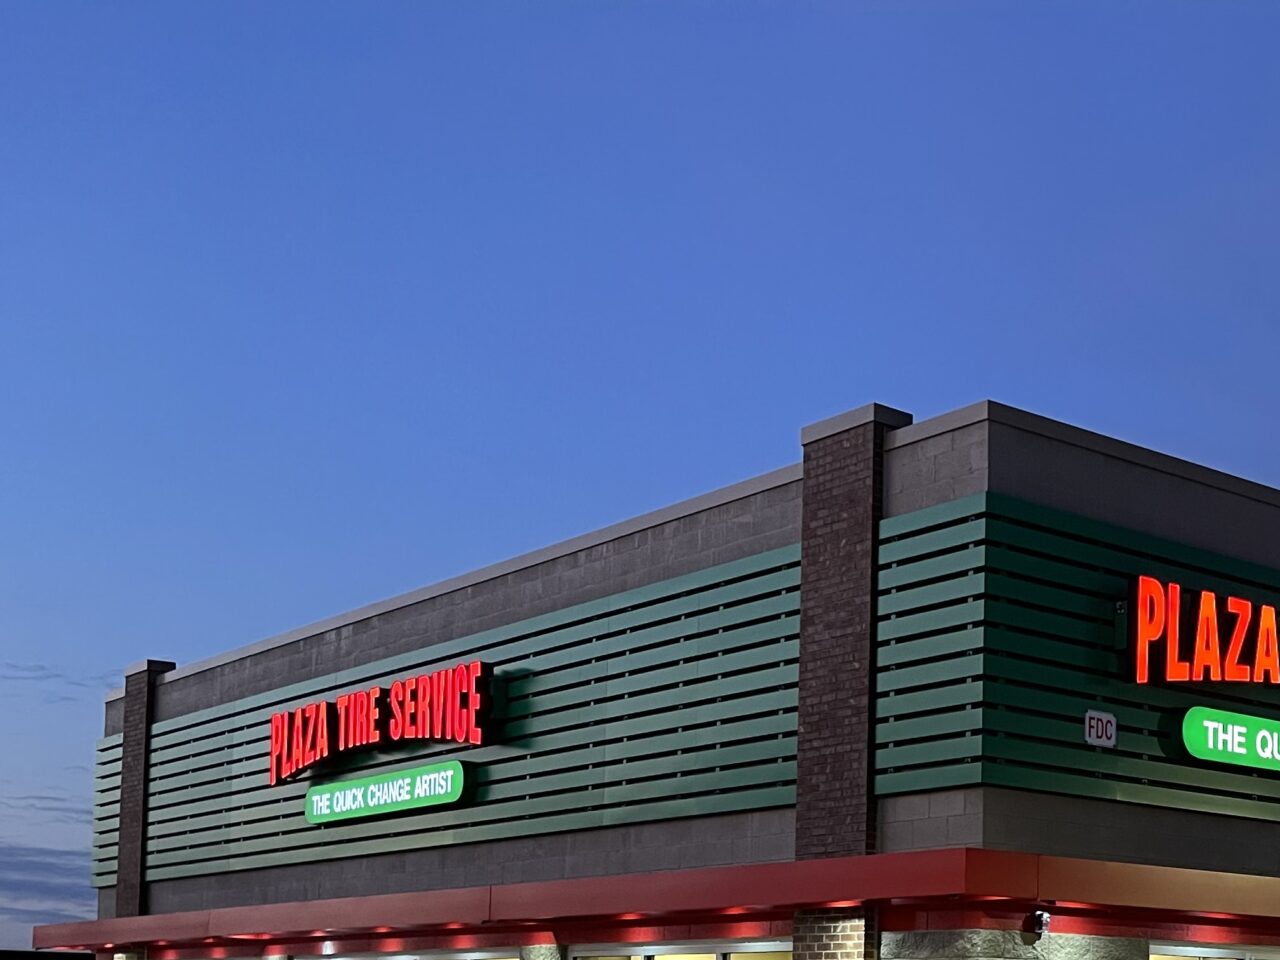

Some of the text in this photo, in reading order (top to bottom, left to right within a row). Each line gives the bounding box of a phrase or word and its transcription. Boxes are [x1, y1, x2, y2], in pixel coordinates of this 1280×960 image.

[269, 660, 483, 786] PLAZA TIRE SERVICE
[1088, 716, 1113, 741] FDC
[1203, 719, 1247, 755] THE
[311, 770, 454, 816] THE QUICK CHANGE ARTIST
